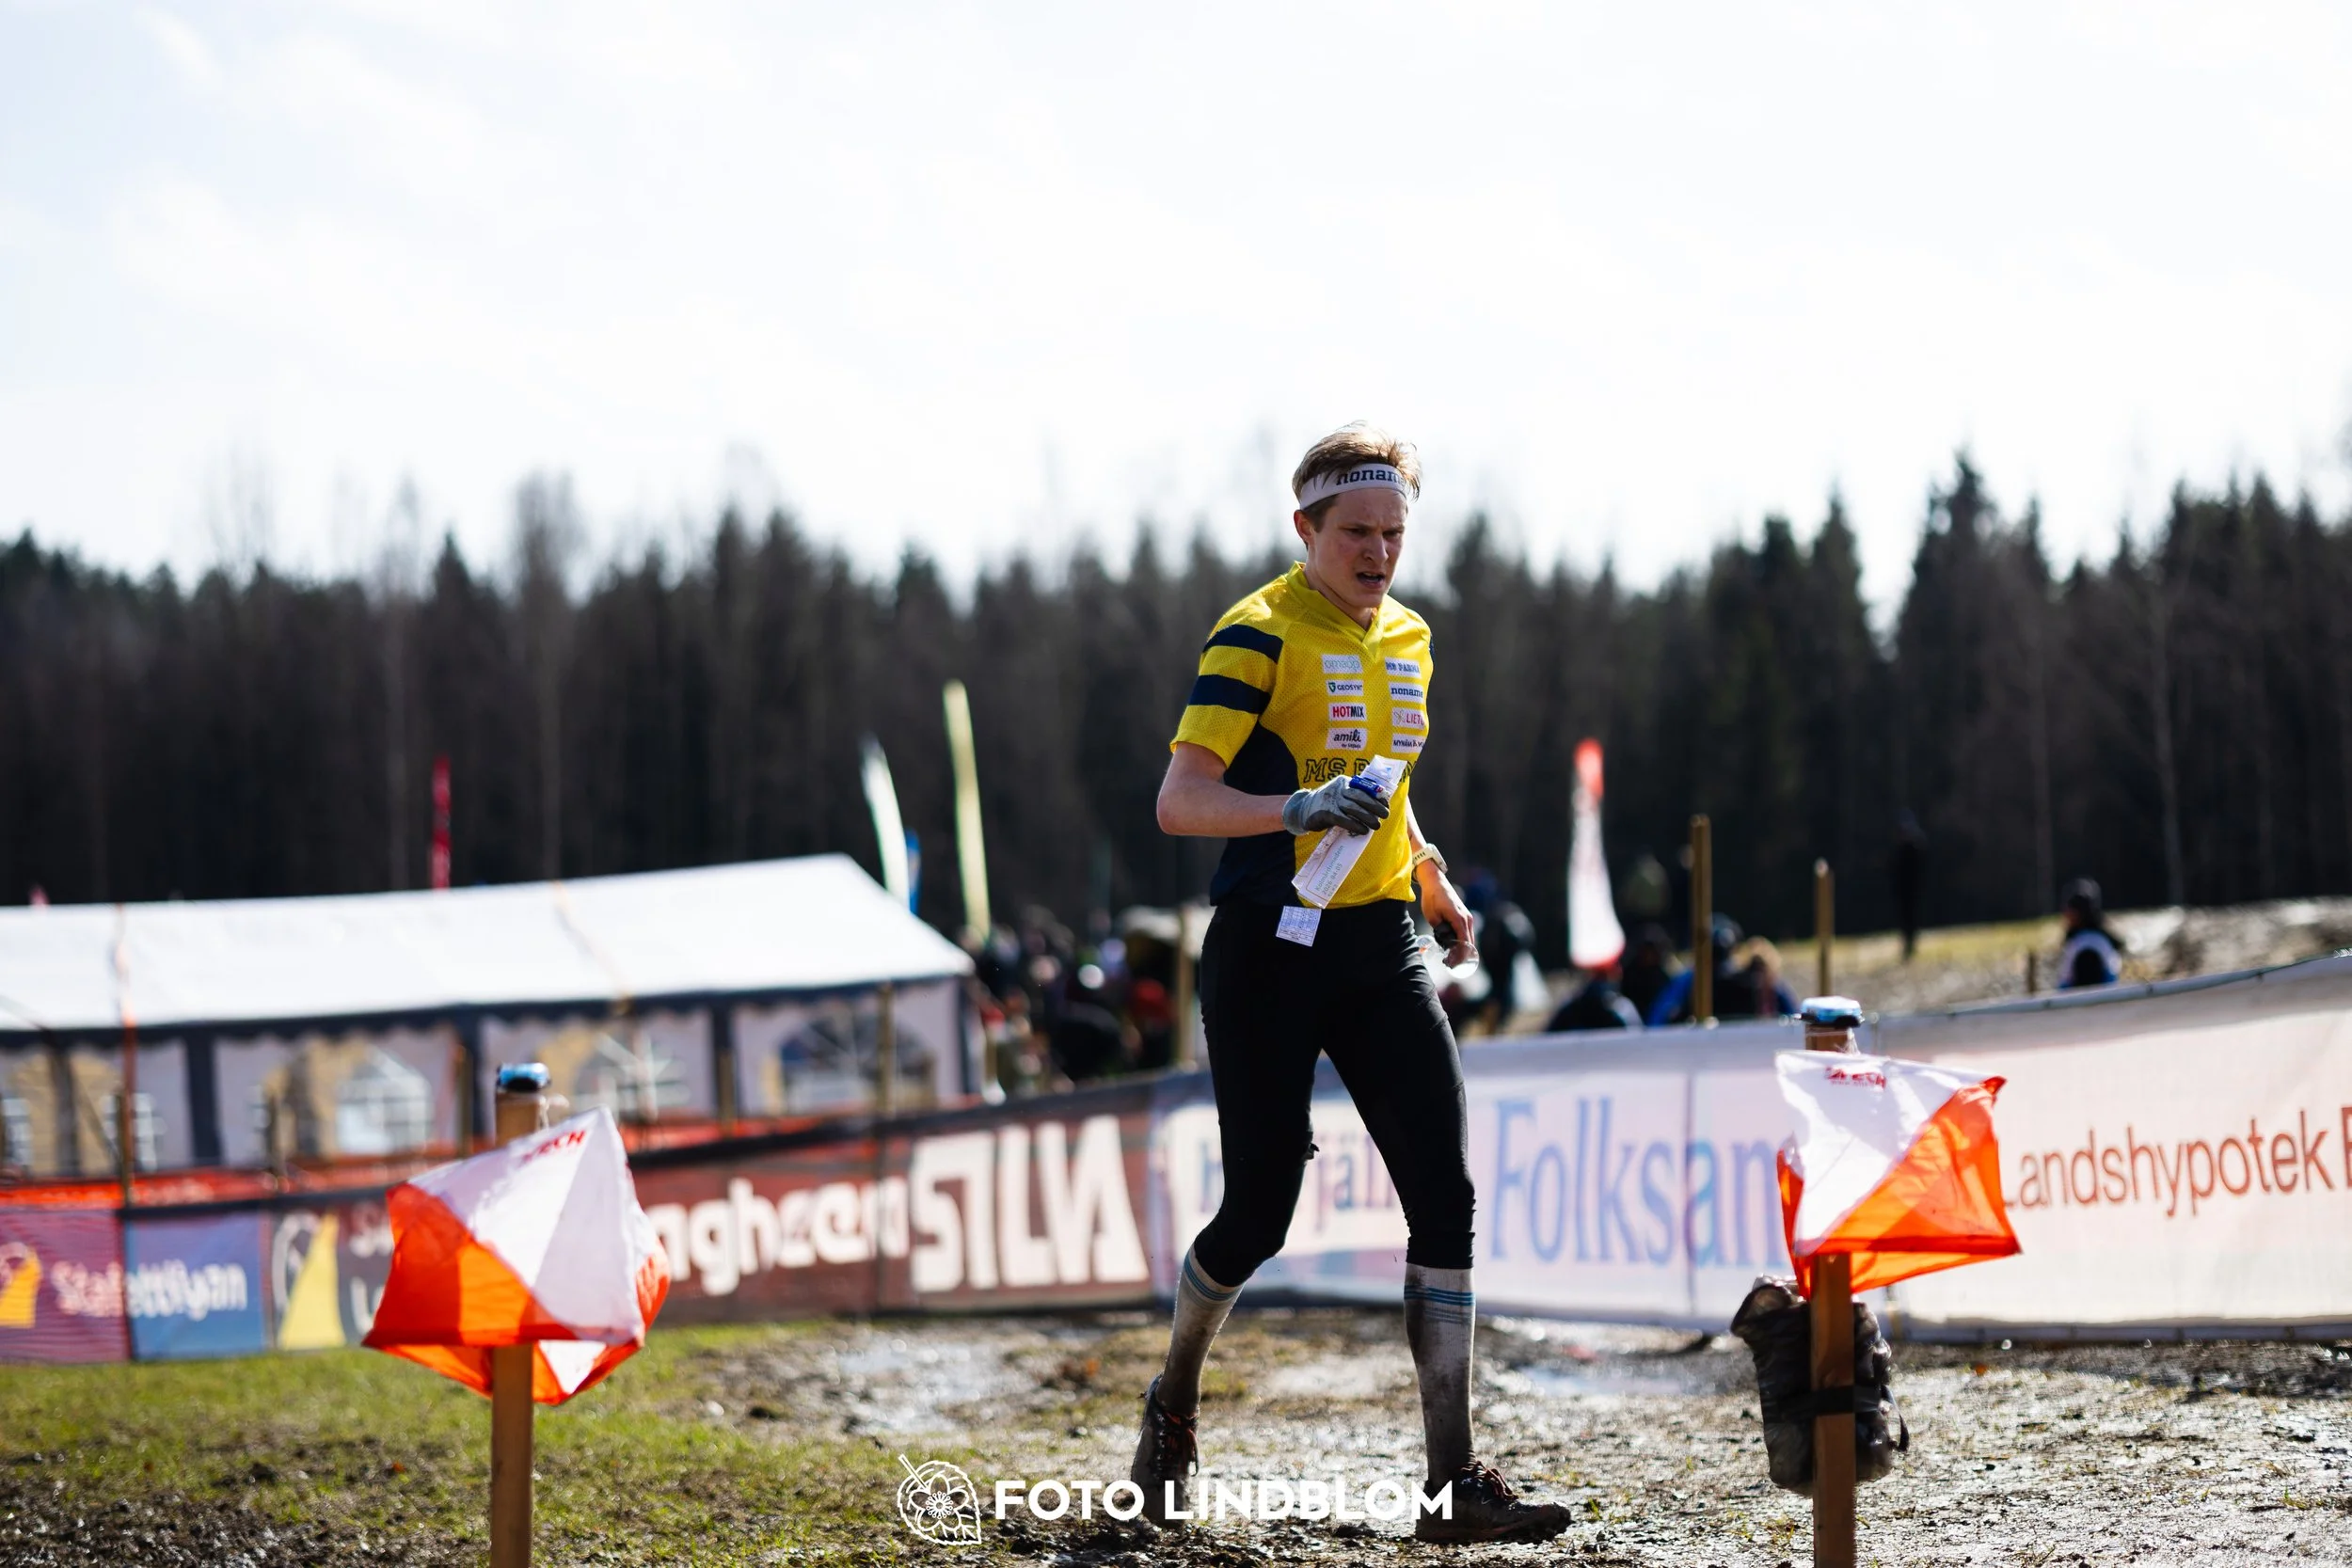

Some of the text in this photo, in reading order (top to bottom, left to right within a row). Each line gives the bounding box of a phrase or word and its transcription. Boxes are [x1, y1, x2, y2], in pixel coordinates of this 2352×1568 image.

[1332, 706, 1364, 718] HOTMIX
[1333, 728, 1361, 742] amili
[1303, 757, 1347, 783] MS
[2006, 1110, 2335, 1217] andshypotek
[911, 1116, 1150, 1292] SILVA
